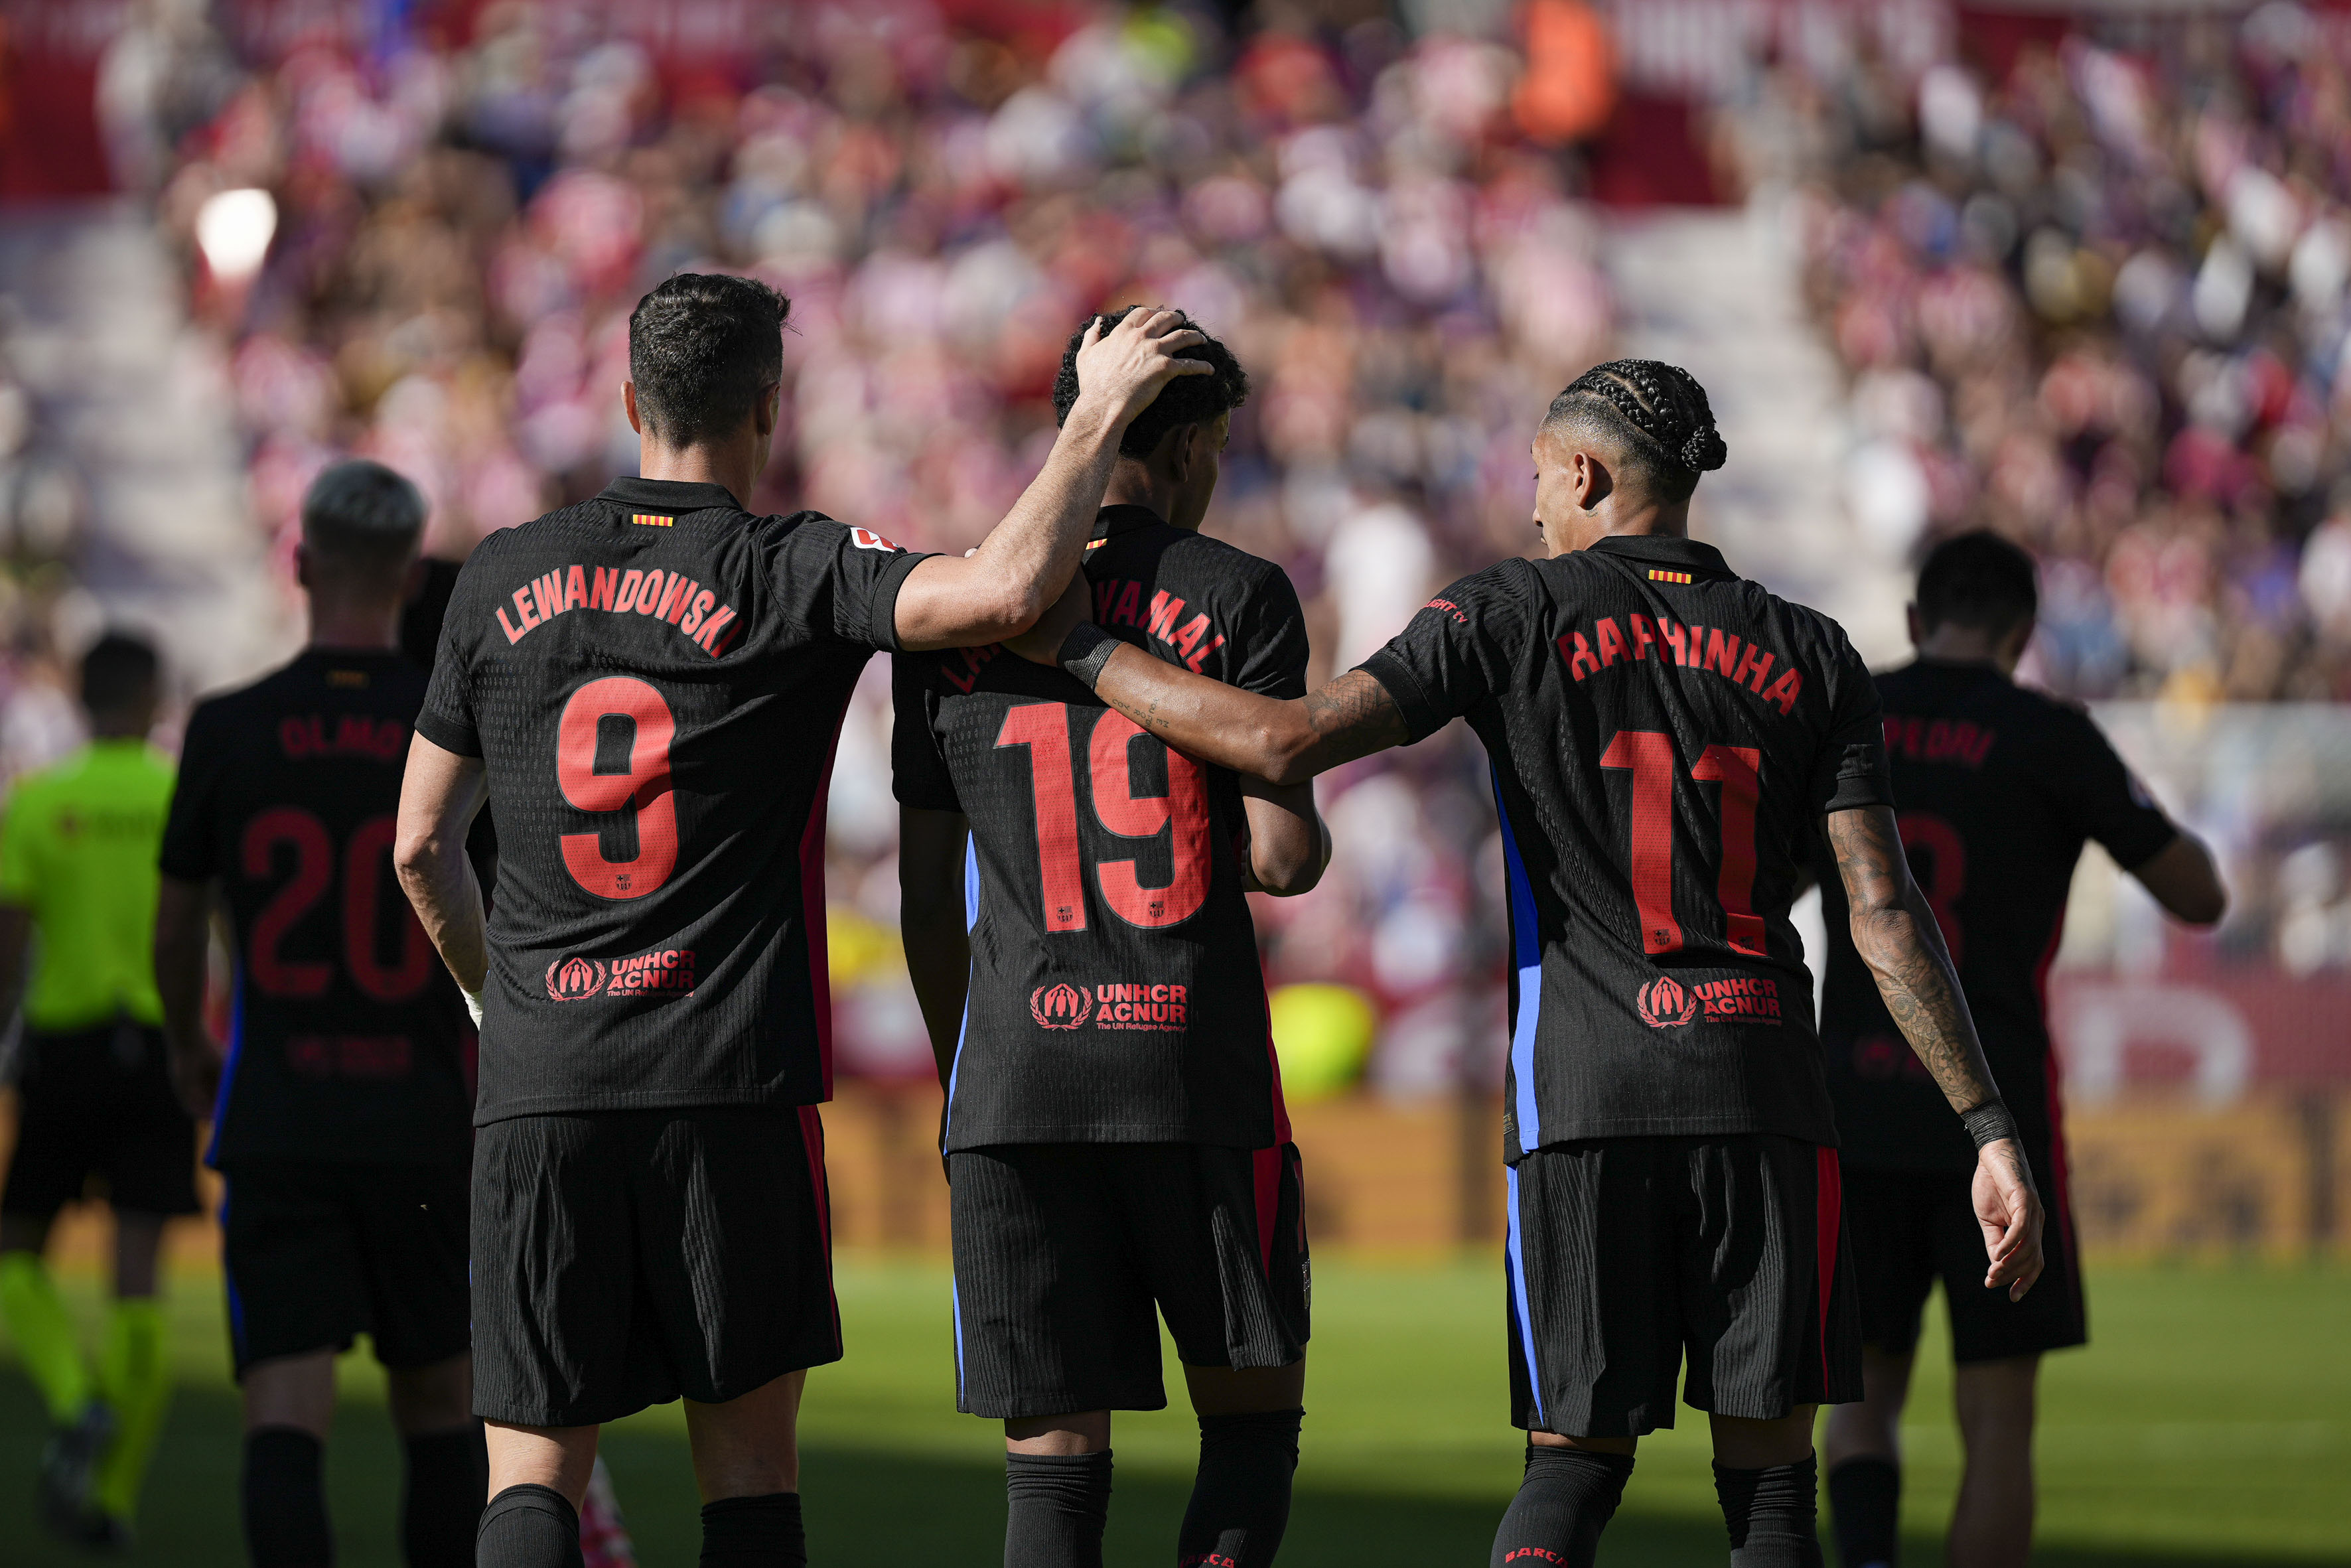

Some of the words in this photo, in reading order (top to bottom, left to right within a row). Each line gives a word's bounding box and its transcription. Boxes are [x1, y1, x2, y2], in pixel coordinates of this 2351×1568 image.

[495, 564, 744, 660] LEWANDOWSKI
[1097, 579, 1226, 674] YAMAL
[1555, 612, 1804, 716] RAPHINHA
[281, 714, 405, 759] OLMO
[556, 675, 679, 902] 9
[993, 700, 1212, 935] 19
[1599, 729, 1773, 959] 11
[240, 803, 436, 1003] 20
[606, 969, 695, 991] ACNUR
[611, 950, 696, 975] UNHCR
[1097, 983, 1186, 1003] UNHCR
[1693, 978, 1778, 1001] UNHCR
[1703, 996, 1782, 1017] ACNUR
[1096, 1003, 1187, 1023] ACNUR
[1125, 1023, 1157, 1032] Refugee
